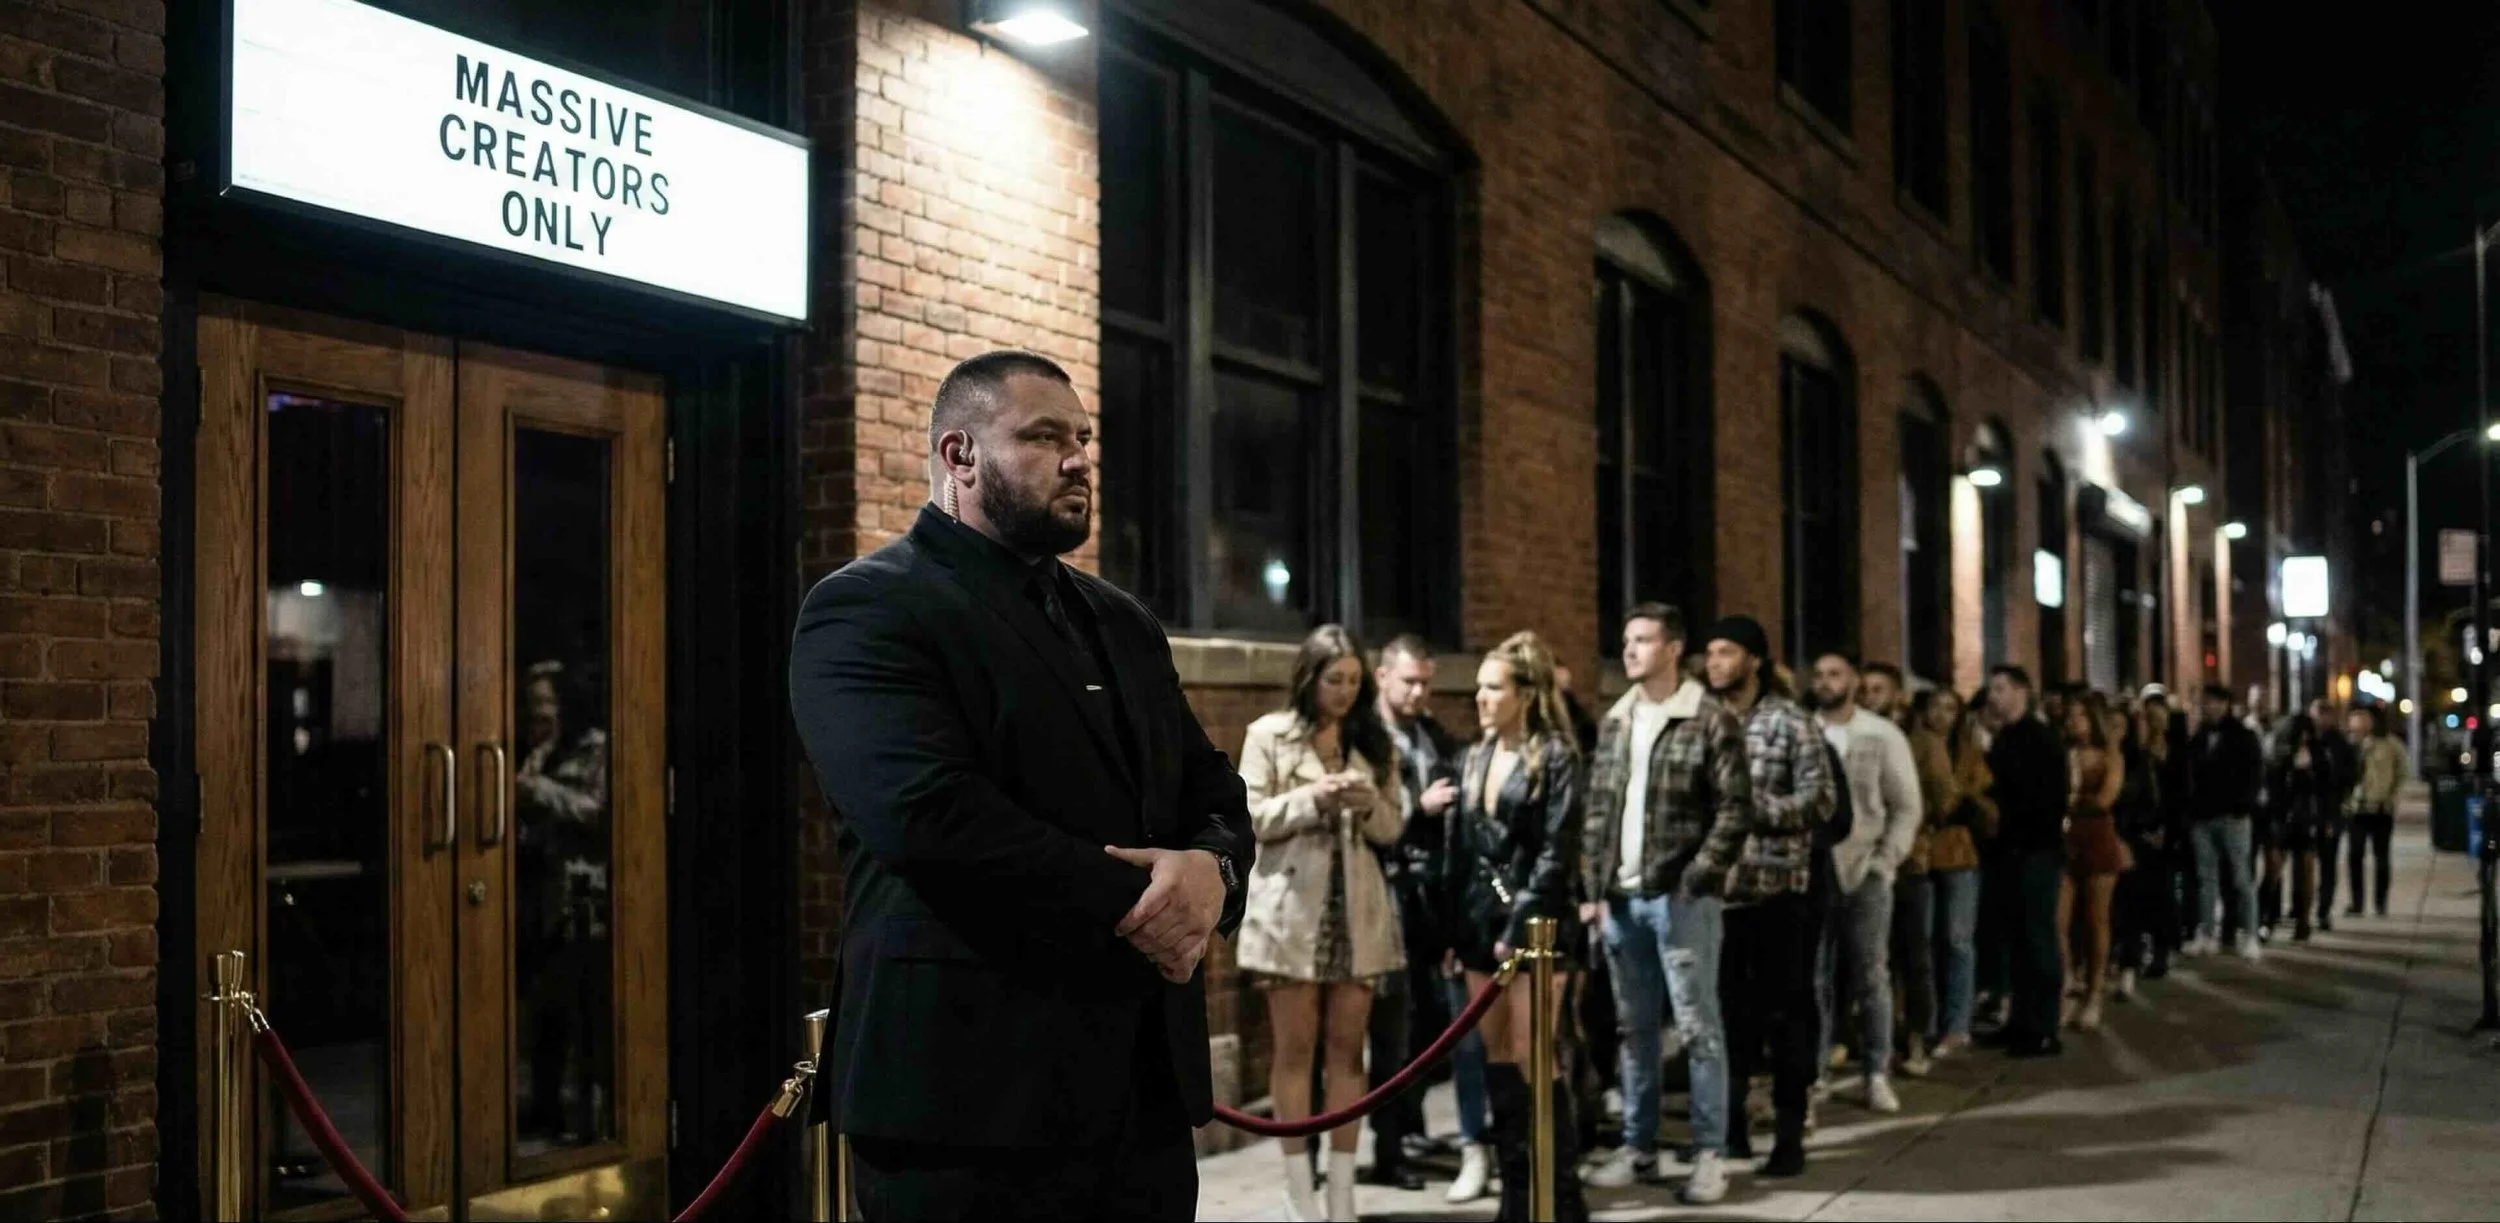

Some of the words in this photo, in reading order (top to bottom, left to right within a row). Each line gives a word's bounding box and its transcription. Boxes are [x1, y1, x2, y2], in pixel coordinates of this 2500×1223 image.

[456, 54, 653, 157] MASSIVE
[439, 113, 669, 215] CREATORS
[502, 190, 612, 256] ONLY
